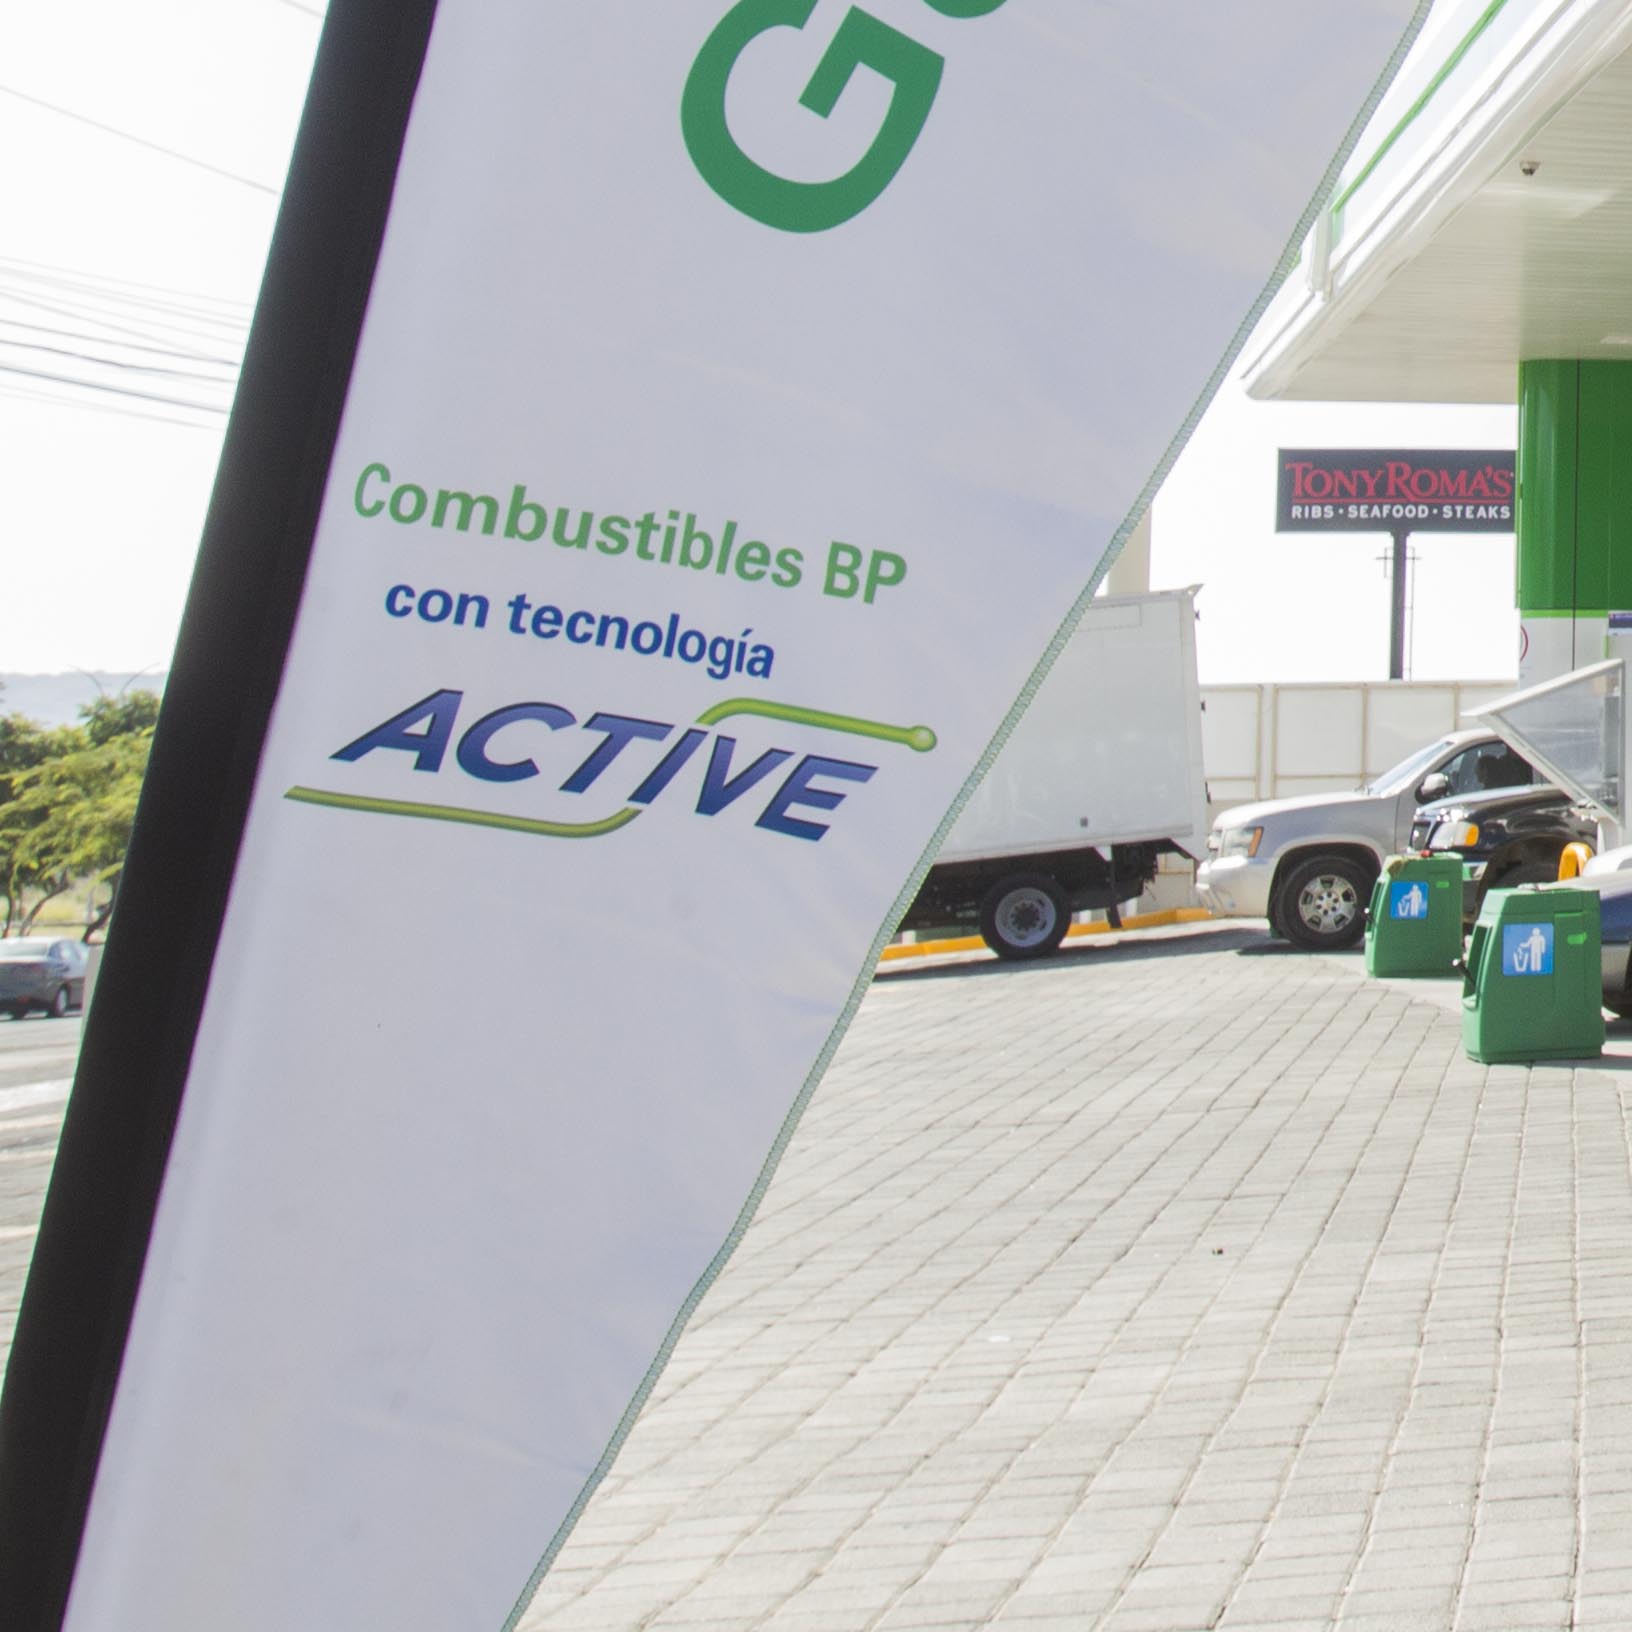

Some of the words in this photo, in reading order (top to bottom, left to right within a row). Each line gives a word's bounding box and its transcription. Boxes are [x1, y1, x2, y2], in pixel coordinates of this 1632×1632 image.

[1285, 461, 1385, 498] TONY
[1292, 505, 1334, 519] RIBS
[1348, 505, 1429, 519] SEAFOOD
[1443, 505, 1511, 519] STEAKS
[354, 462, 805, 588] Combustibles
[823, 541, 908, 604] BP
[385, 583, 490, 629] con
[507, 592, 776, 680] tecnología
[329, 688, 880, 842] ACTIVE
